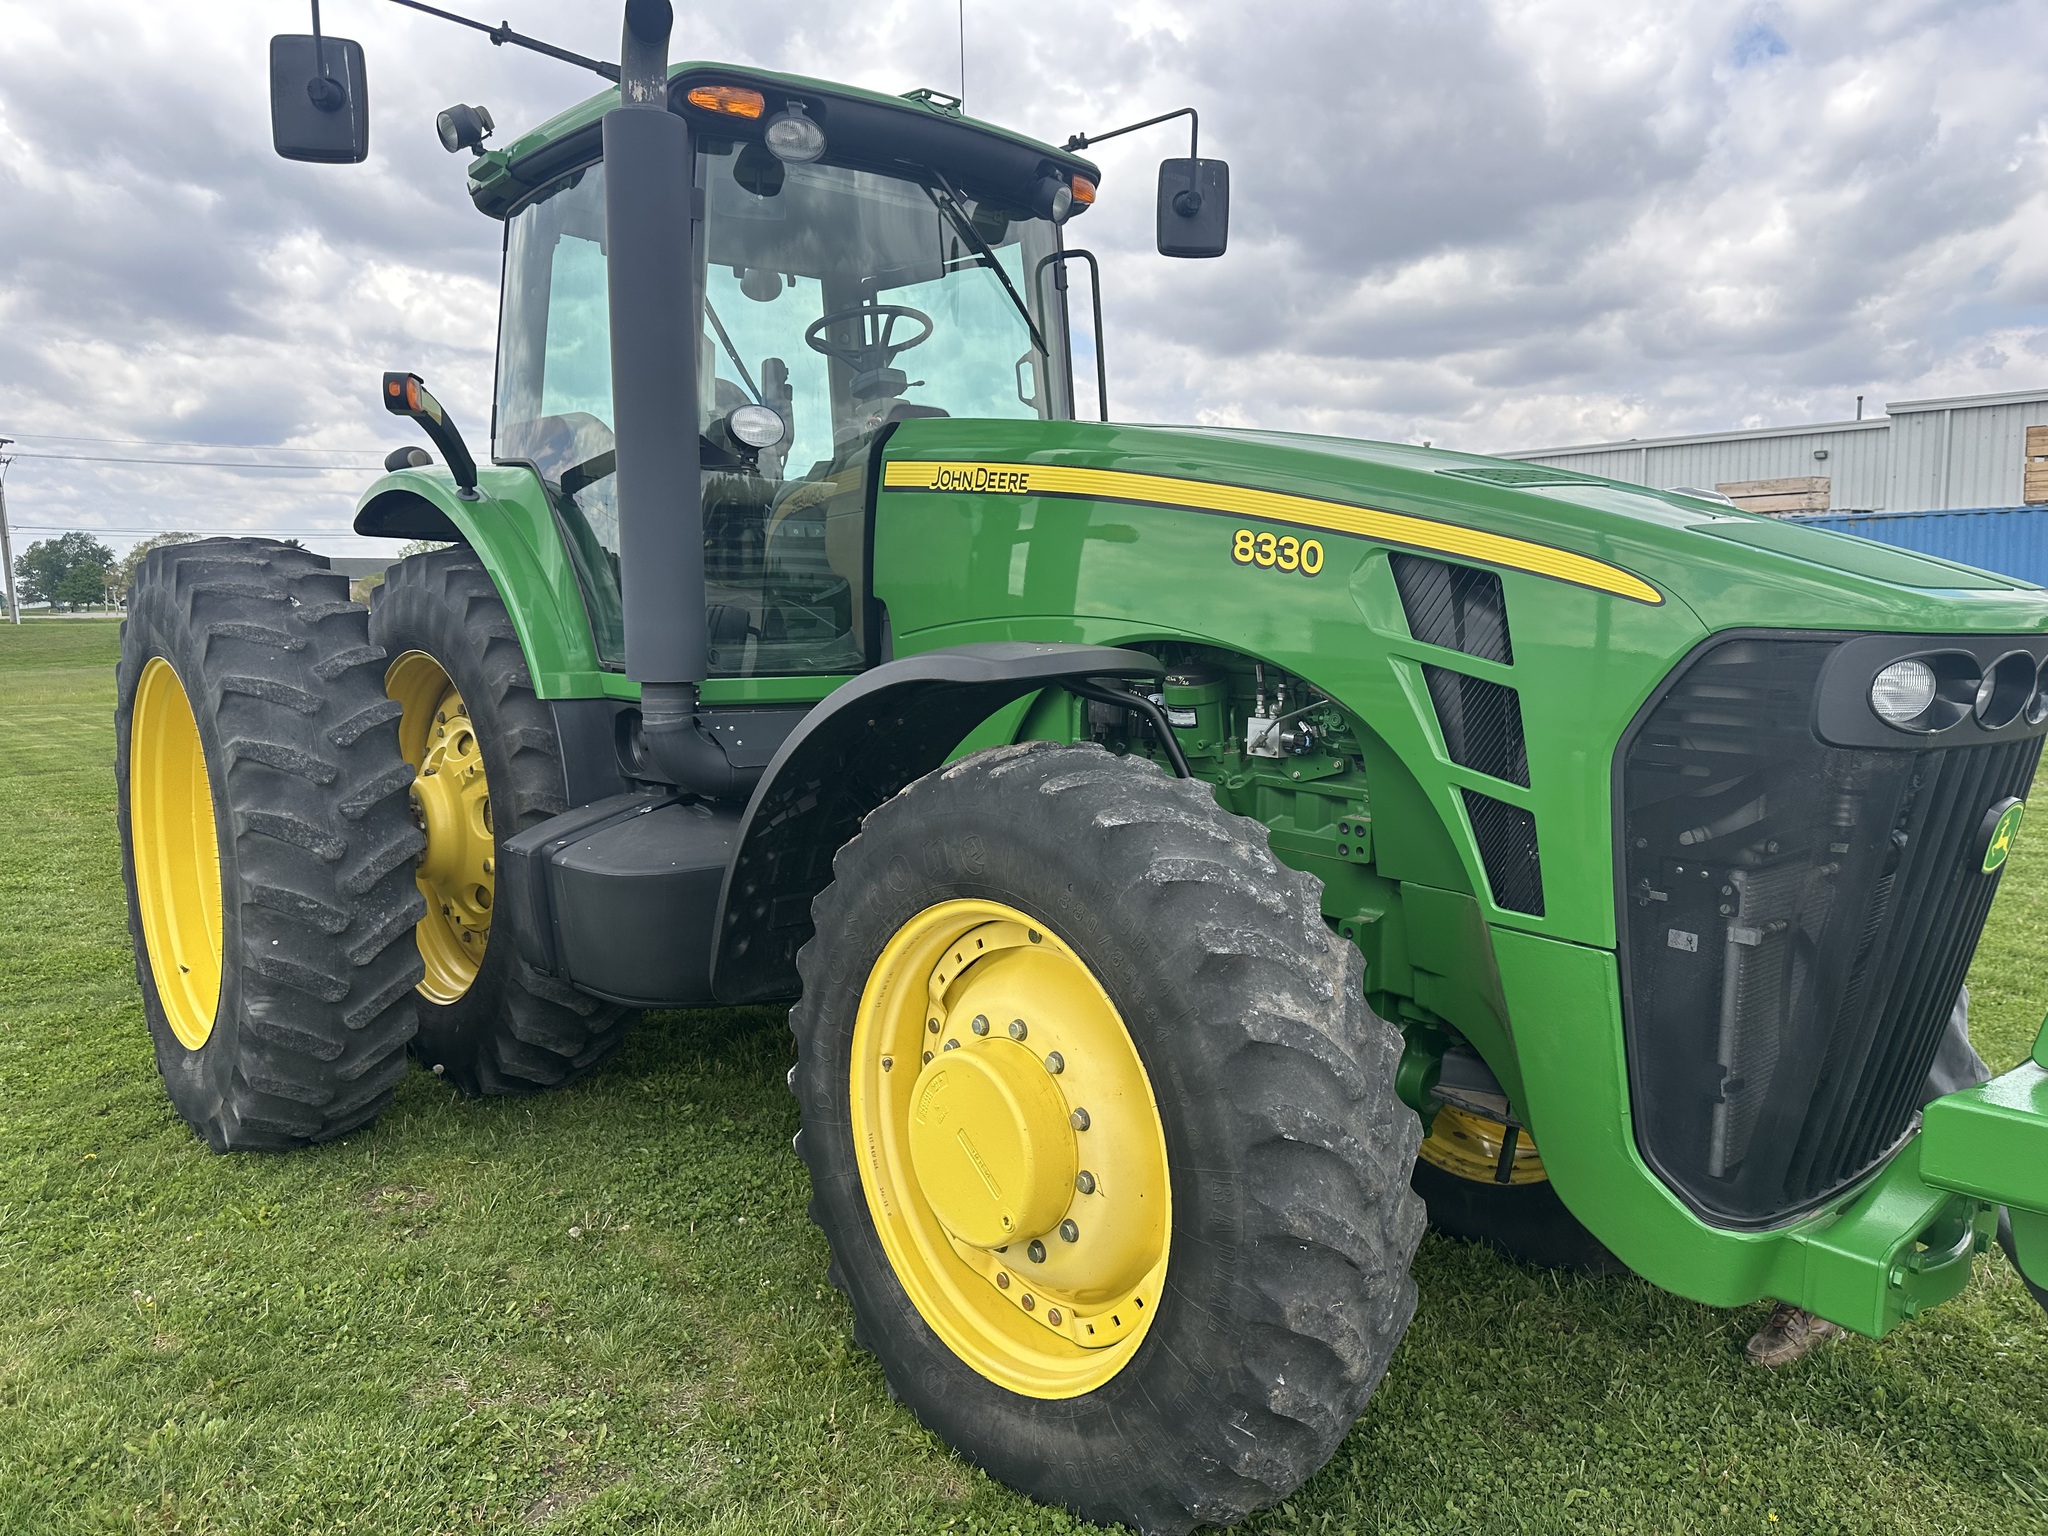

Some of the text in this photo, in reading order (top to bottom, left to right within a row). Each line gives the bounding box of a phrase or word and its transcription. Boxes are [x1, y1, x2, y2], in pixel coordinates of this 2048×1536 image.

[930, 466, 1030, 494] JOHN DEERE
[1231, 529, 1325, 578] 8330
[1089, 879, 1176, 1000] 149R34
